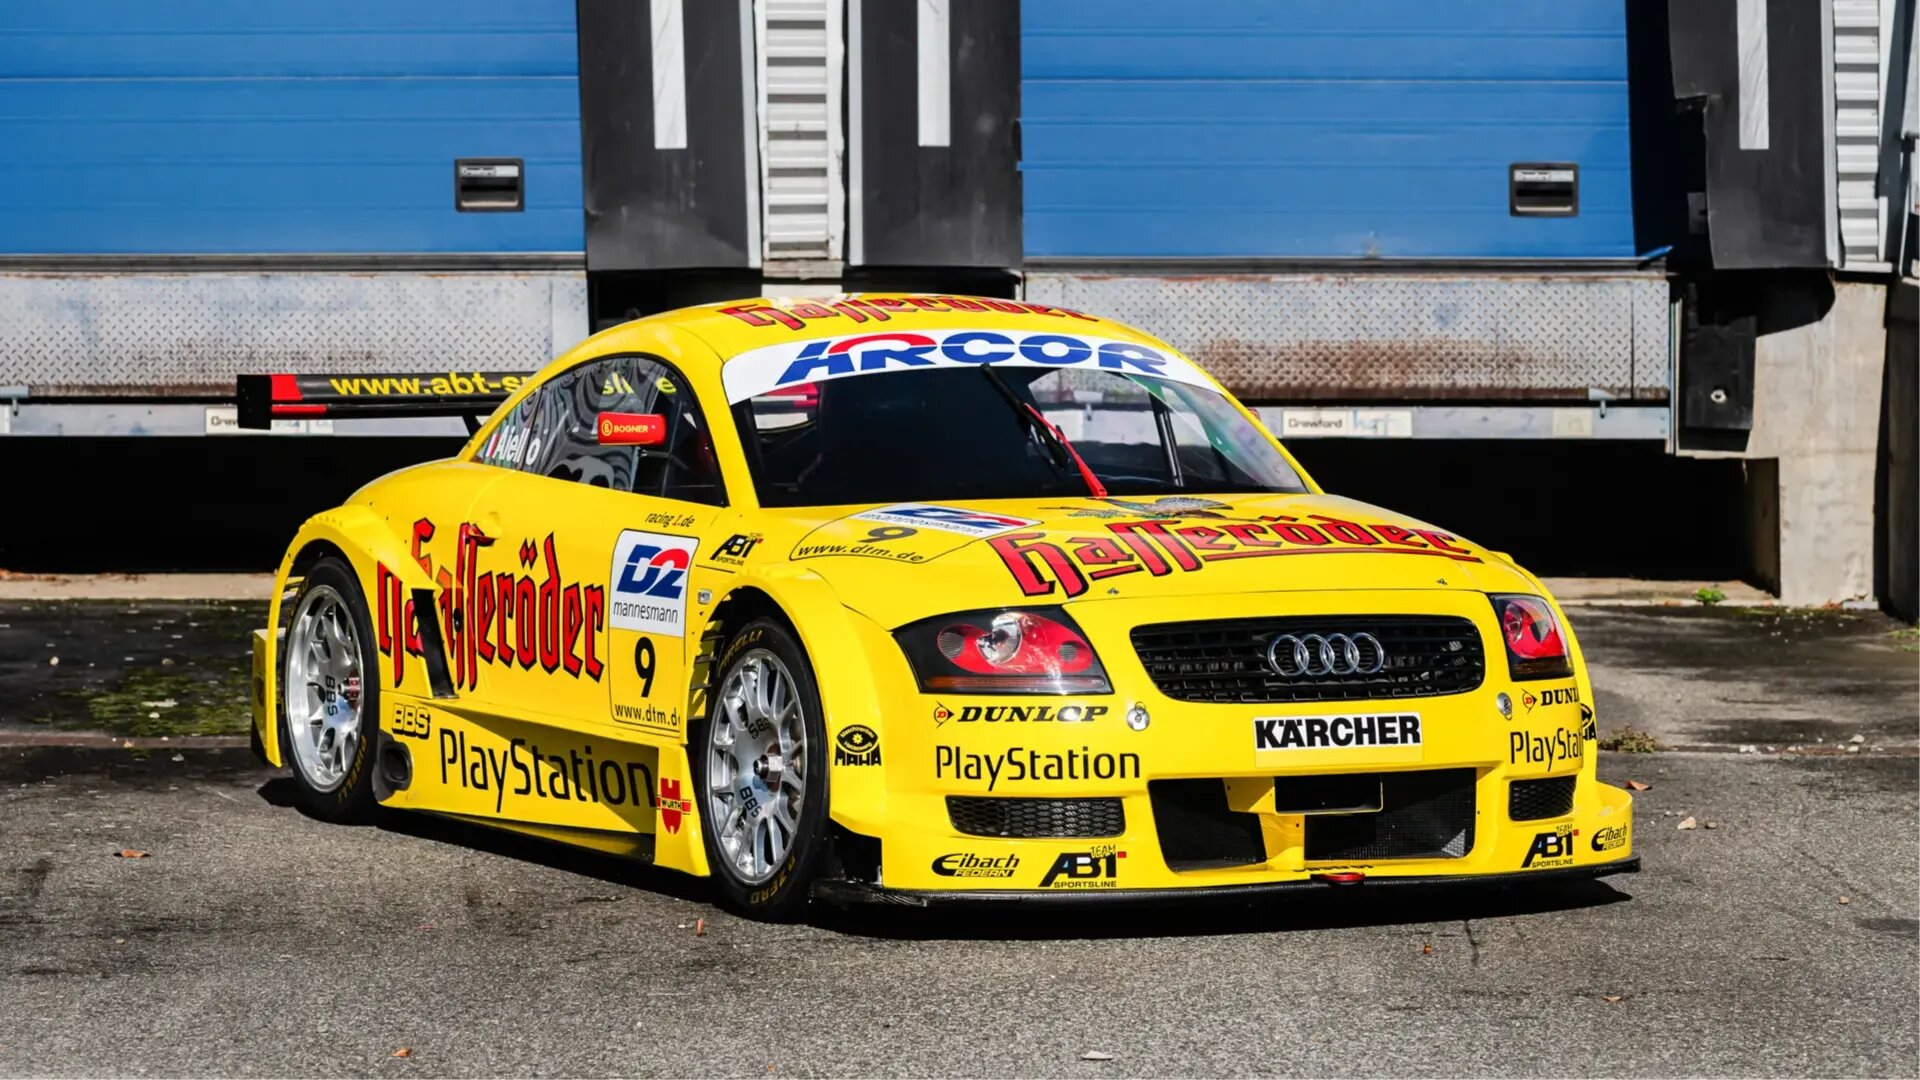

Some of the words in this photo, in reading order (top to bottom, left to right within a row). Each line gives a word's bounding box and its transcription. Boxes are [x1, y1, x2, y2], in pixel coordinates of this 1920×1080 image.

[775, 331, 1169, 385] ARCOR
[613, 424, 649, 433] BOGNER
[710, 533, 759, 561] ABT
[857, 526, 918, 543] 9
[798, 543, 925, 564] www.dtm.de
[617, 544, 690, 599] D2
[613, 600, 679, 624] mannesmann
[634, 636, 656, 698] 9
[326, 675, 338, 716] BBS
[392, 704, 430, 740] BBS
[614, 703, 681, 726] www.dtm.d
[957, 706, 1108, 722] DUNLOP
[1256, 715, 1420, 749] KÄRCHER
[835, 742, 882, 767] MAHA
[439, 728, 658, 813] PlayStation
[936, 746, 1140, 792] PlayStation
[739, 786, 760, 817] BBS
[1089, 845, 1116, 859] TEAM
[1521, 831, 1573, 868] ABT
[1532, 859, 1574, 868] SPORTSLINE
[931, 853, 1020, 877] Eibach
[953, 869, 1014, 877] FEDERN
[1038, 853, 1117, 887] ABT
